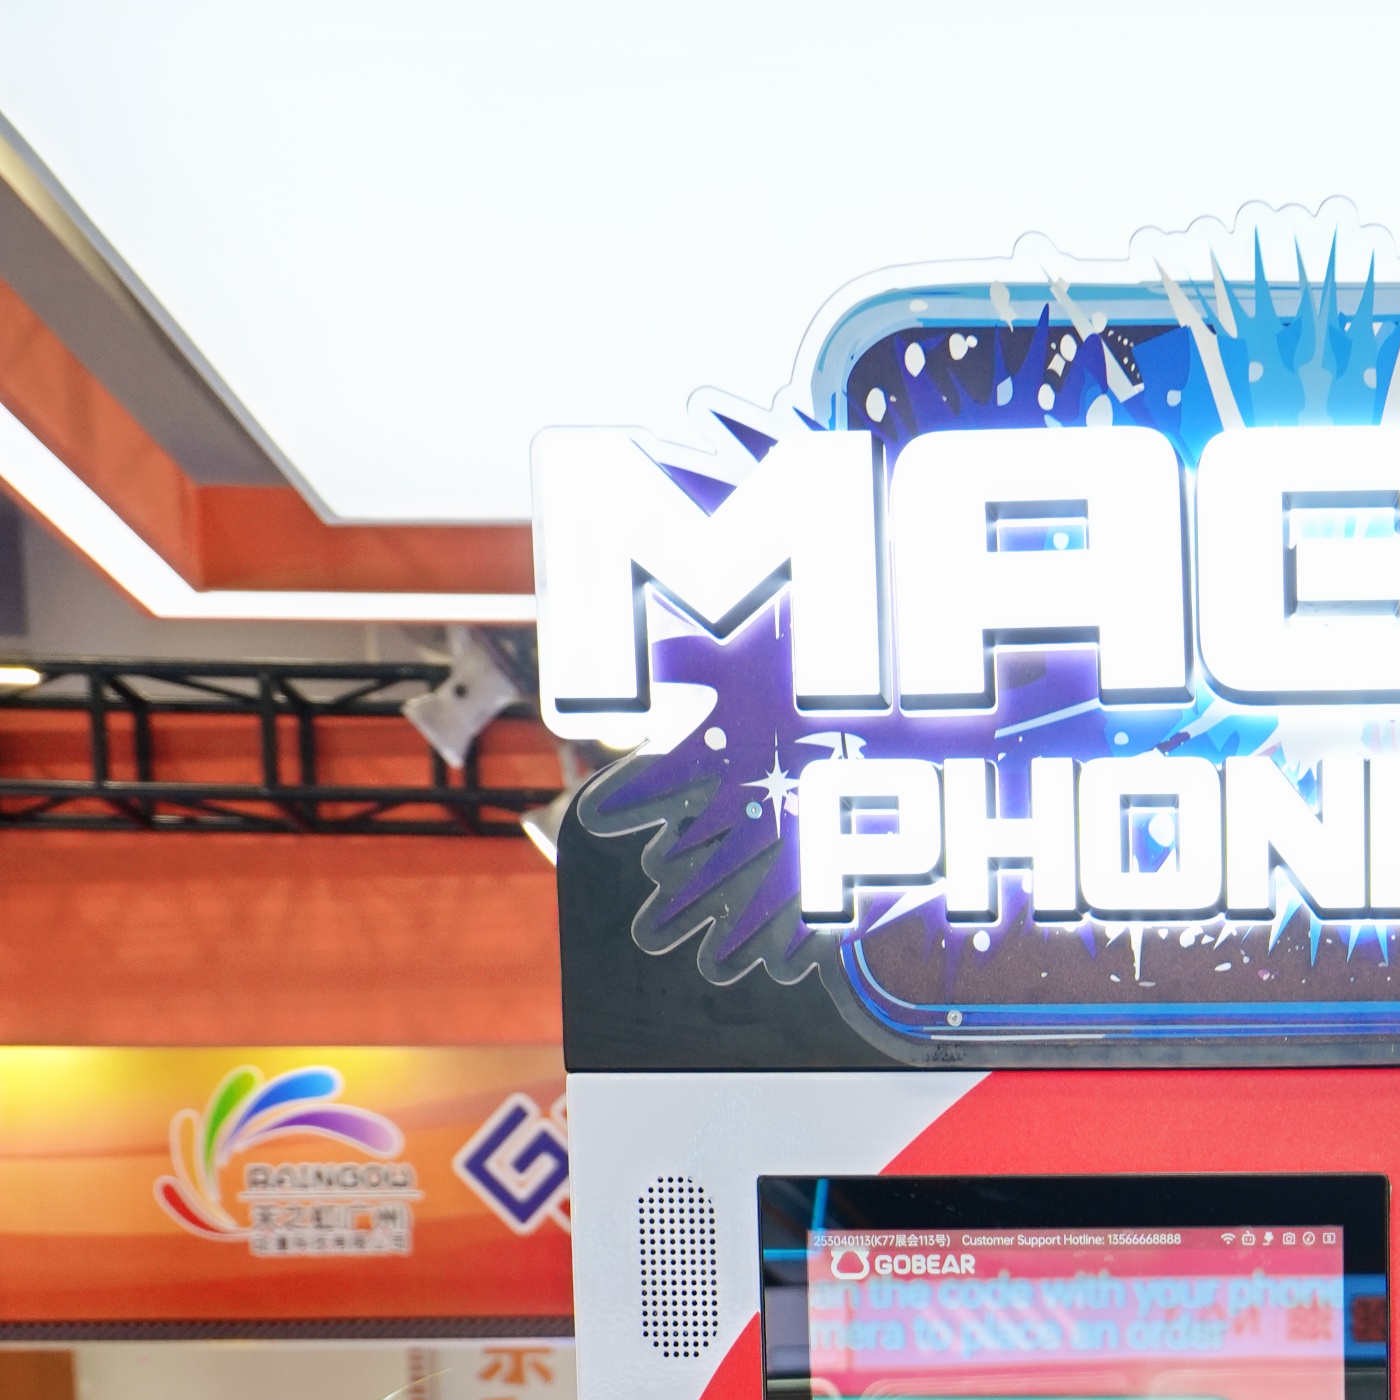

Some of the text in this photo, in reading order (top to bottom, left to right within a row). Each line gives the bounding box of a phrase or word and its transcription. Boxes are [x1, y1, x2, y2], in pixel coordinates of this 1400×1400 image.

[961, 1234, 1015, 1247] Customer
[1017, 1233, 1062, 1248] Support
[1063, 1233, 1105, 1246] Hotline:
[873, 1253, 976, 1276] GOBEAR
